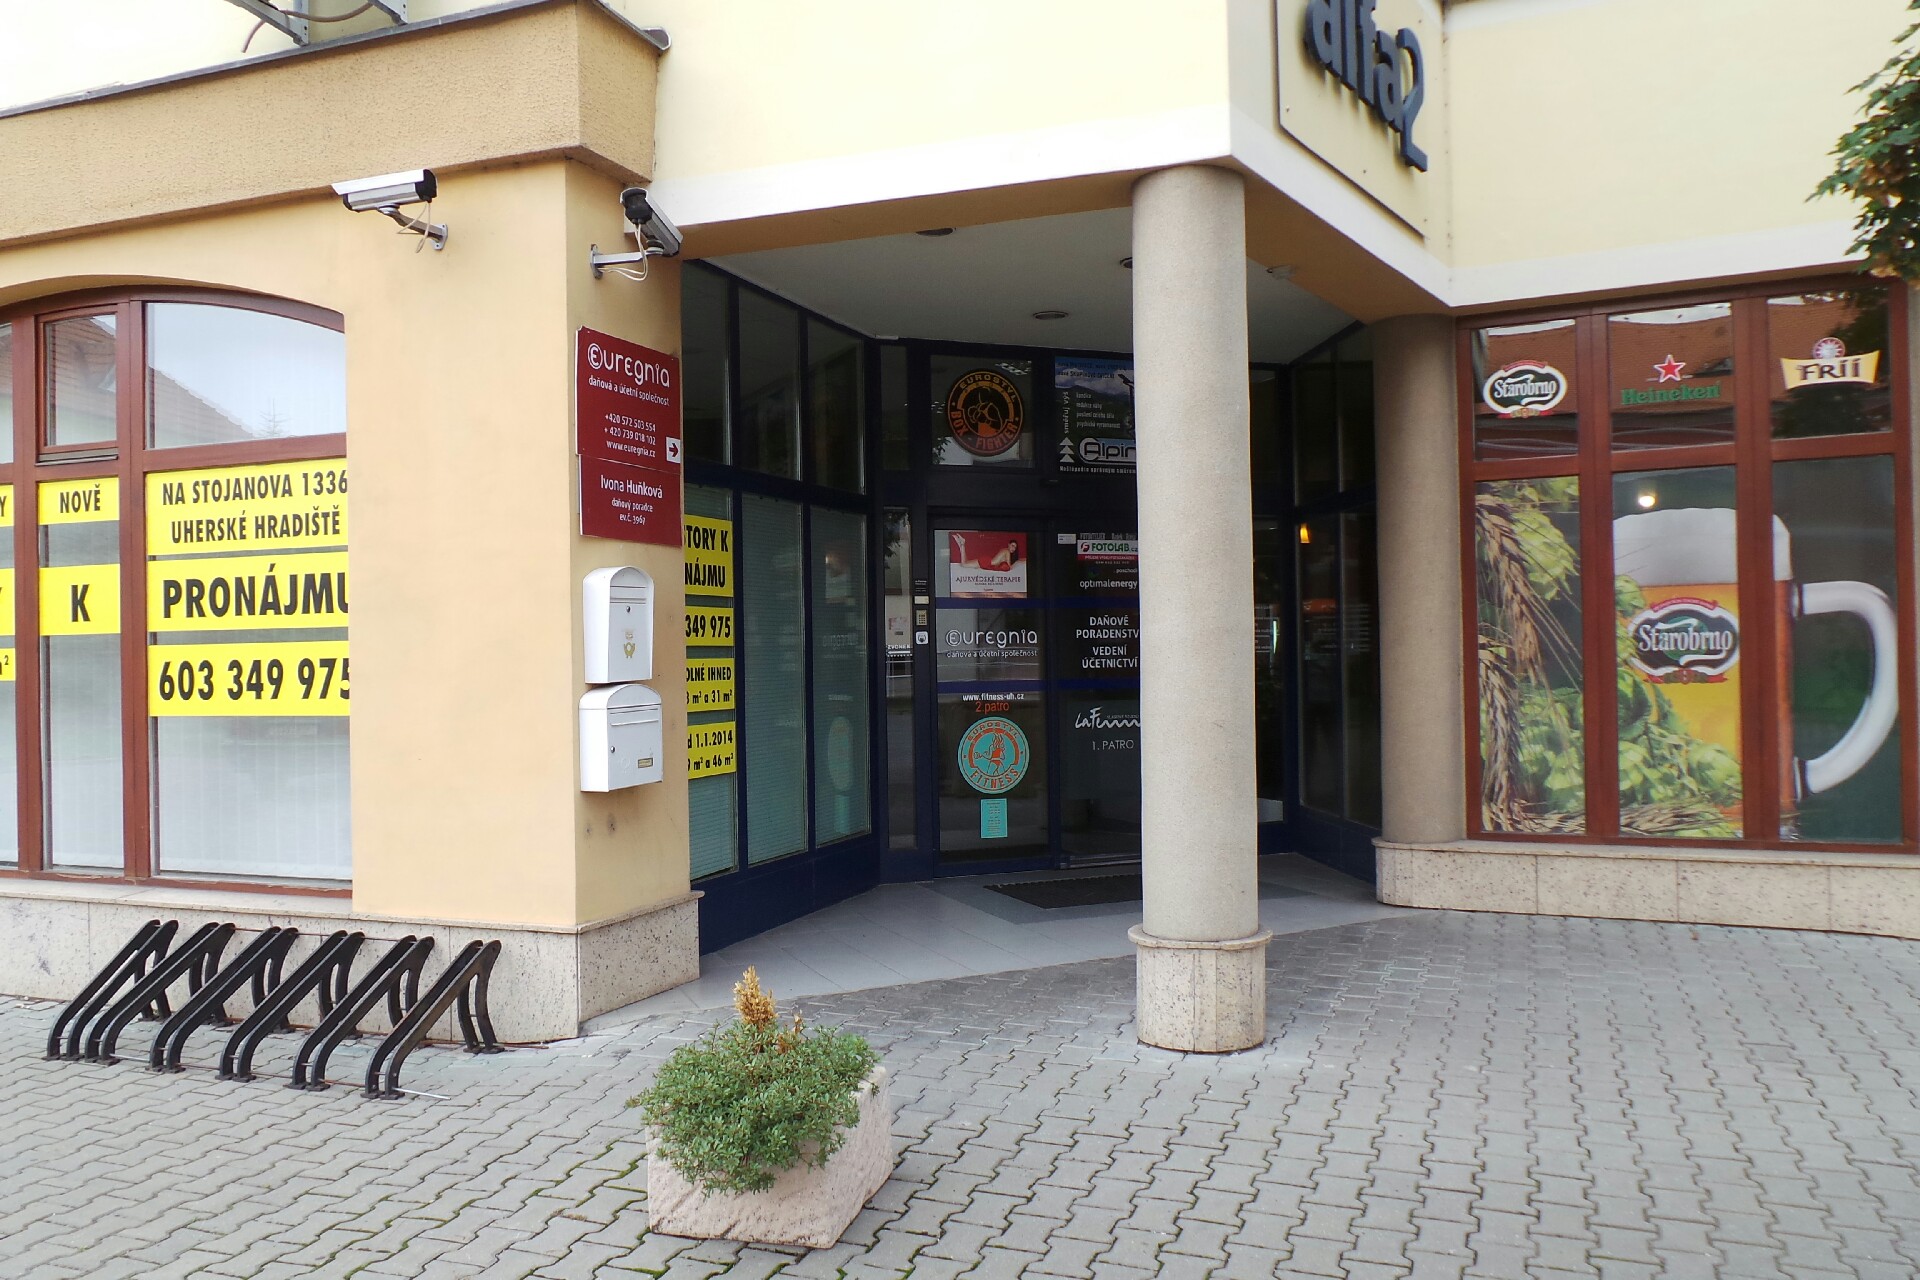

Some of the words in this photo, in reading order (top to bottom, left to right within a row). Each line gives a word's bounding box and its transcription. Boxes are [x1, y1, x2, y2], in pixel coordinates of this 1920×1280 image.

[588, 376, 613, 391] daňová
[613, 384, 618, 392] a
[619, 383, 638, 397] účetní
[639, 391, 670, 406] společnost
[959, 374, 1016, 402] EUROSTYL
[1494, 376, 1557, 400] Starobrno
[1620, 383, 1721, 405] Heineken
[605, 413, 621, 424] +420
[621, 416, 633, 427] 572
[634, 419, 645, 430] 503
[950, 410, 969, 437] BOX
[609, 426, 622, 437] 420
[623, 429, 634, 440] 739
[976, 422, 1018, 448] FIGHTER
[606, 440, 656, 458] www.euregnia.cz
[162, 481, 186, 506] NA
[192, 473, 294, 504] STOJANOVA
[302, 469, 348, 496] 1336
[600, 474, 624, 492] Ivona
[626, 479, 663, 499] Huňková
[59, 484, 101, 514] NOVĚ
[632, 502, 654, 513] poradce
[171, 510, 247, 544] UHERSKÉ
[254, 505, 340, 539] HRADIŠTĚ
[684, 524, 716, 551] TORY
[720, 529, 729, 552] K
[71, 584, 90, 623] K
[710, 615, 731, 638] 975
[1089, 614, 1129, 626] DAŇOVÉ
[1638, 620, 1733, 657] Starobrno
[1001, 650, 1037, 658] společnost
[1092, 644, 1128, 656] VEDENÍ
[1082, 656, 1138, 668] ÚČETNICTVÍ
[159, 660, 214, 701] 603
[227, 658, 284, 700] 349
[707, 667, 732, 681] IHNED
[704, 693, 709, 703] a
[712, 690, 720, 703] 31
[962, 692, 1024, 701] www.fitness-uh.cz
[696, 729, 733, 748] 1.1.2014
[967, 722, 1018, 741] EUROSTYL
[1092, 740, 1100, 751] 1.
[1102, 739, 1134, 750] PATRO
[705, 759, 710, 768] a
[712, 754, 722, 767] 46
[971, 768, 1019, 789] FITNESS
